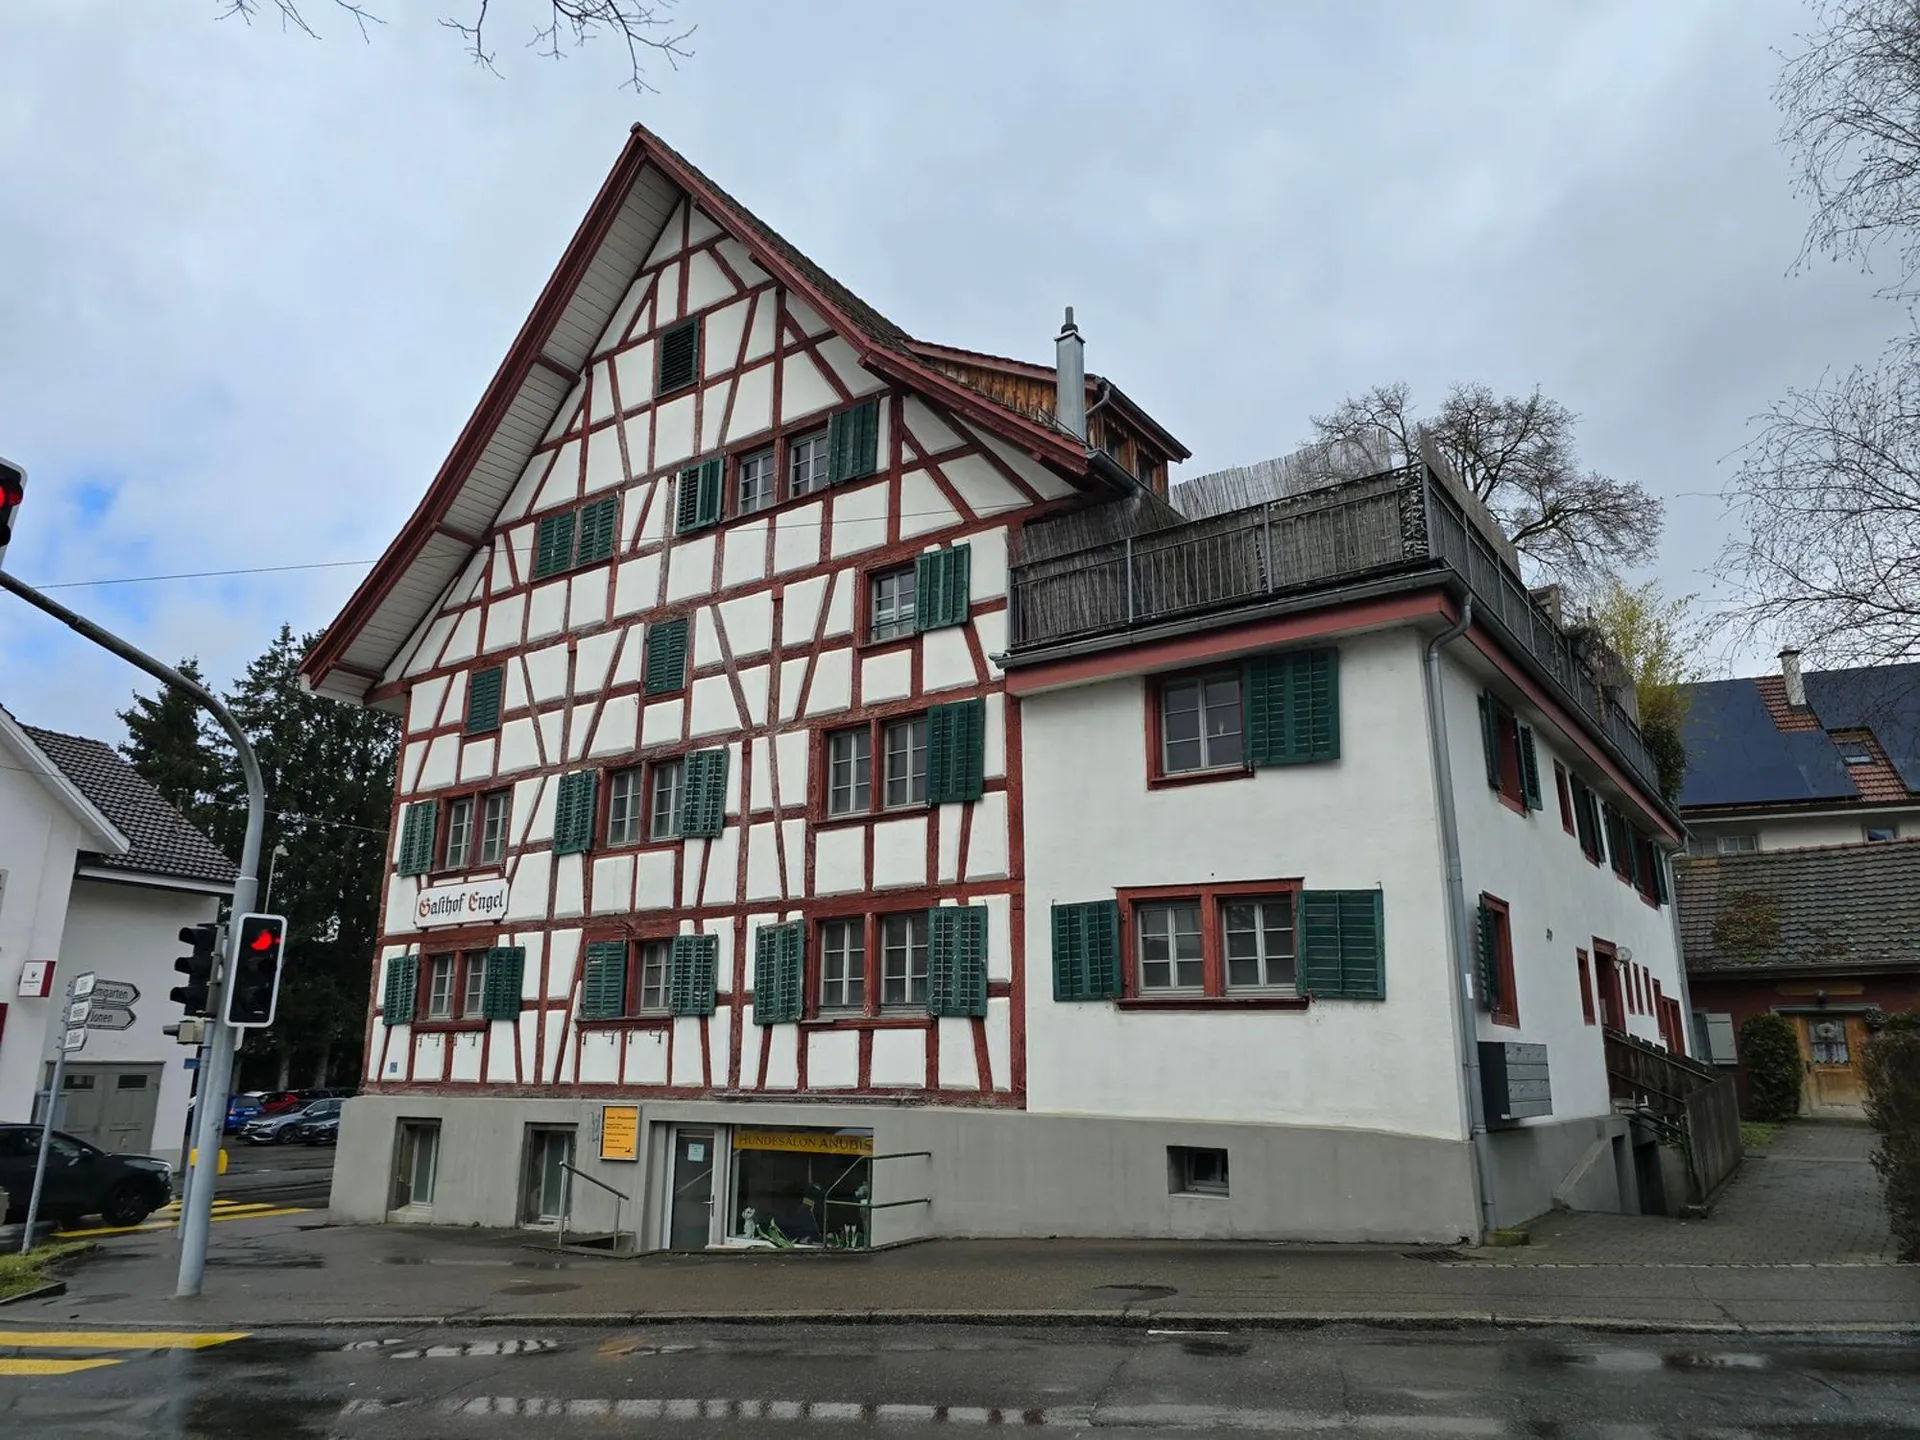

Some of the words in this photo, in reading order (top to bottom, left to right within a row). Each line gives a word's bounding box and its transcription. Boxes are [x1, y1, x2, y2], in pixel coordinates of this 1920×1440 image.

[419, 893, 466, 917] Gasthof
[468, 888, 504, 913] Engel
[738, 1132, 815, 1147] HUNDESALON
[818, 1136, 873, 1151] ANUBIS
